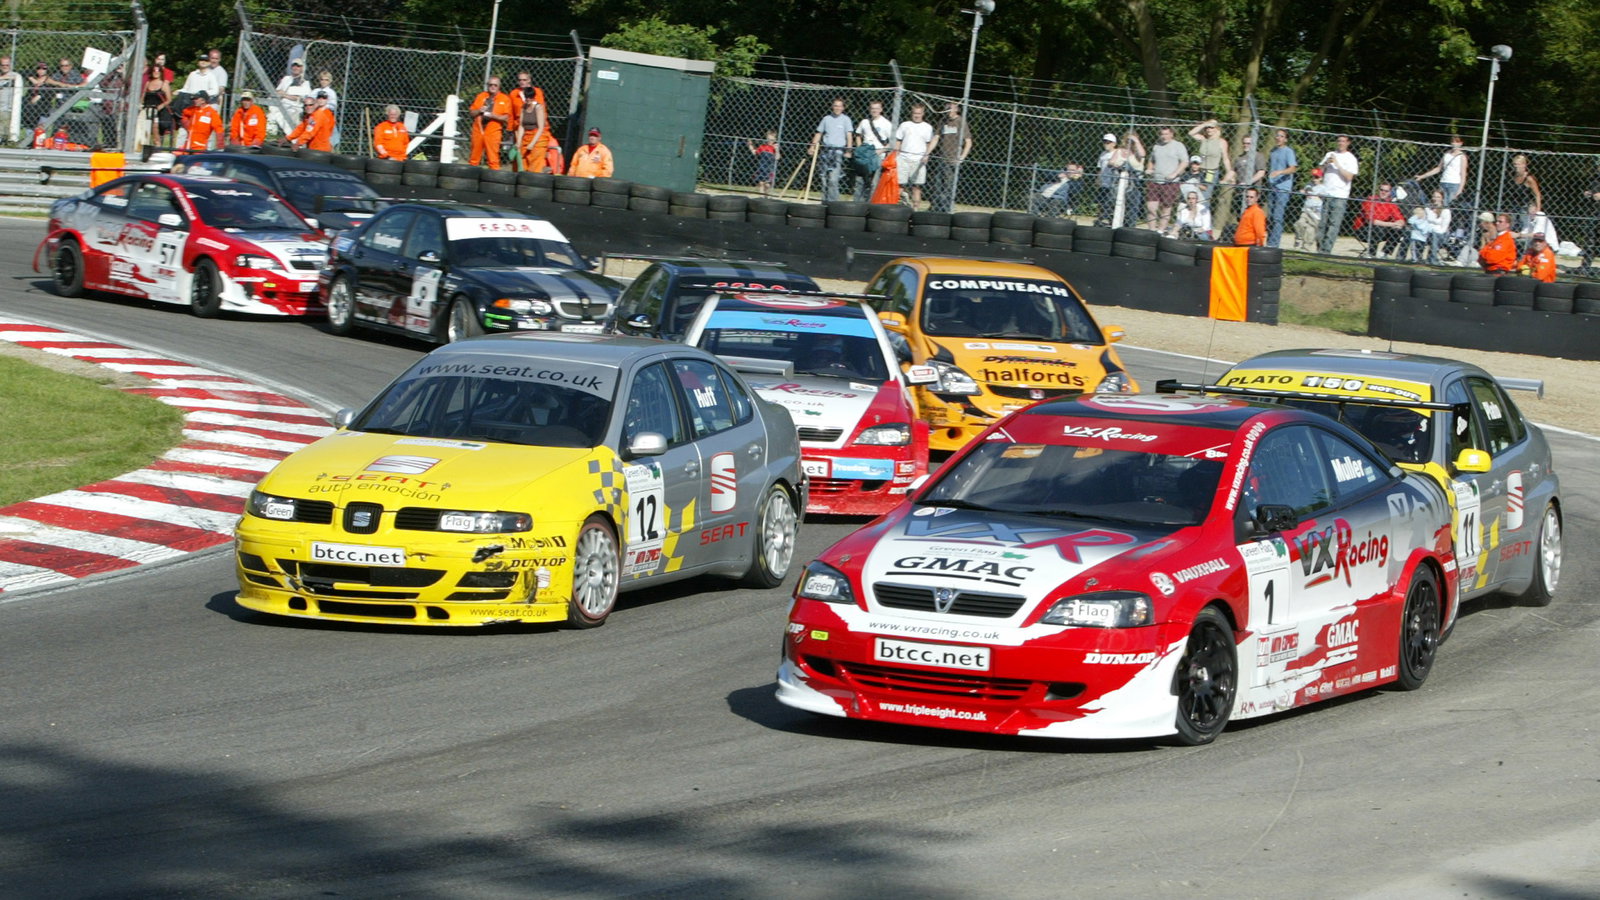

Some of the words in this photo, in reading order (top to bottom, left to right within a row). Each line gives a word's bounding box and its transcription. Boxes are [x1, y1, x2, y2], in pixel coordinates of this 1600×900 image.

[275, 170, 364, 183] HONDA
[160, 242, 177, 266] 57
[929, 279, 1069, 298] COMPUTEACH
[419, 362, 603, 391] www.seat.co.uk
[984, 368, 1085, 387] halfords
[1226, 375, 1294, 387] PLATO
[1305, 375, 1364, 391] 150
[693, 386, 718, 408] Huff
[1331, 455, 1366, 483] Muller
[328, 474, 438, 489] SEAT
[308, 482, 352, 494] auto
[357, 482, 441, 502] emoción
[267, 504, 292, 517] Green
[636, 494, 659, 542] 12
[445, 516, 471, 529] Flag
[700, 522, 749, 546] SEAT
[1463, 512, 1475, 558] 11
[315, 545, 401, 564] btcc.net
[1500, 541, 1533, 562] SEAT
[510, 557, 567, 568] DUNLOP
[893, 556, 1036, 581] GMAC
[1172, 558, 1231, 584] VAUXHALL
[806, 578, 833, 594] Green
[469, 605, 549, 617] www.seat.co.uk
[1078, 604, 1110, 619] Flag
[1263, 579, 1275, 625] 1
[868, 620, 1001, 640] www.vxracing.co.uk
[1326, 619, 1360, 649] GMAC
[880, 641, 985, 668] btcc.net
[1082, 651, 1157, 665] DUNLOP
[878, 701, 987, 721] www.tripleeight.co.uk
